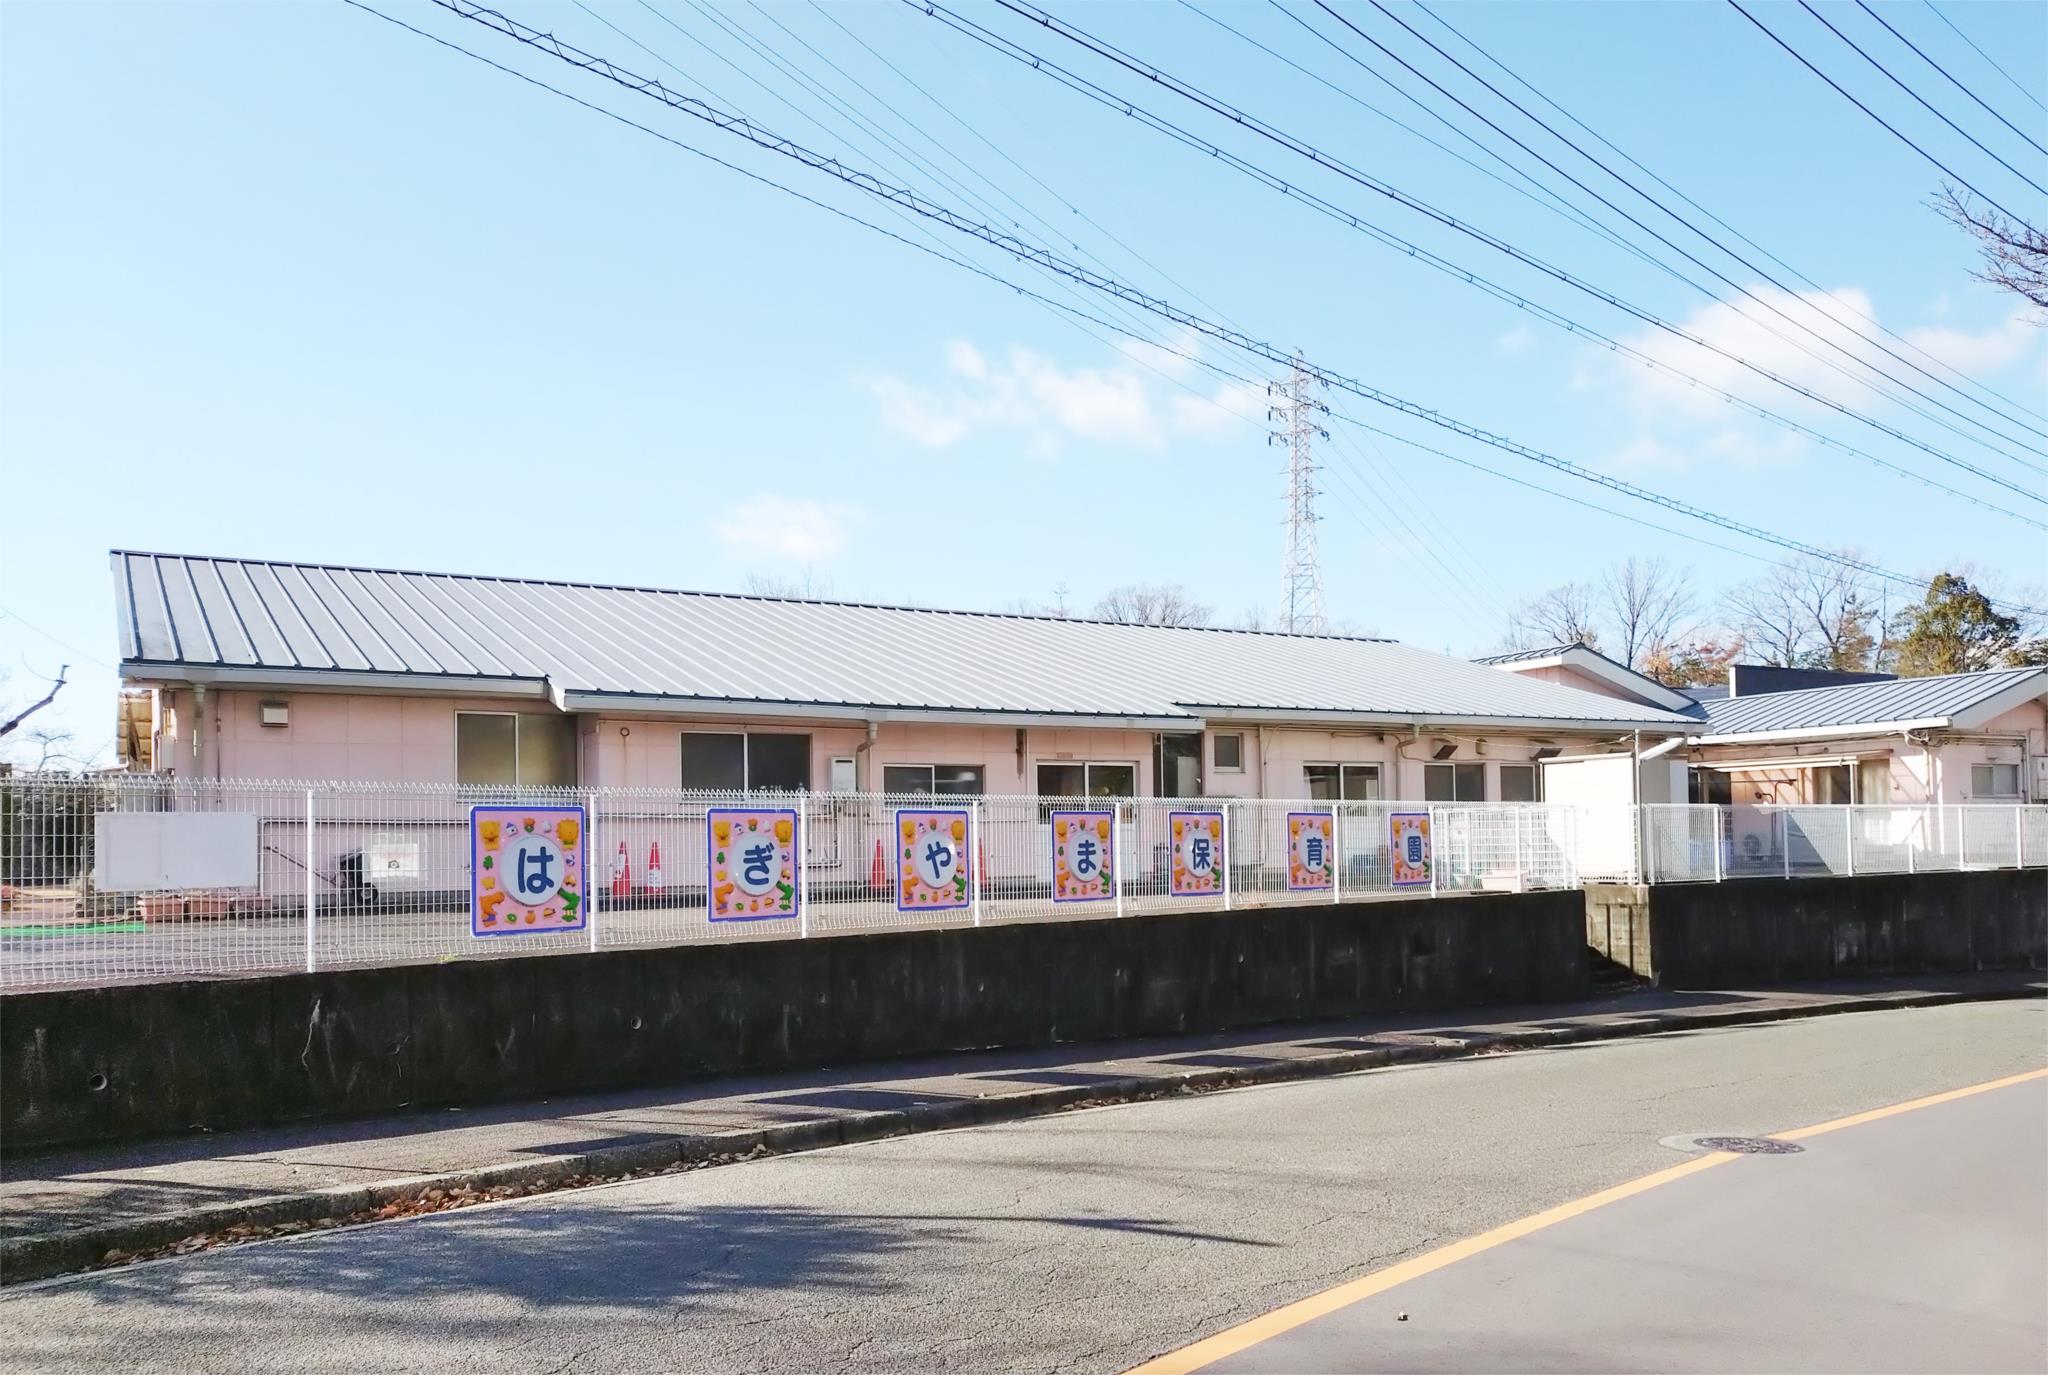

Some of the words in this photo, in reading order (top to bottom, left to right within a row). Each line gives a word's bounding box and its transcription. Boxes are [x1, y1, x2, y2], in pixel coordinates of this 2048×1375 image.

[517, 846, 555, 894] は
[743, 842, 775, 886] ぎ
[925, 841, 952, 879] や
[1077, 839, 1097, 874] ま
[1192, 838, 1211, 870] 保
[1306, 837, 1323, 867] 育
[1407, 835, 1422, 863] 園
